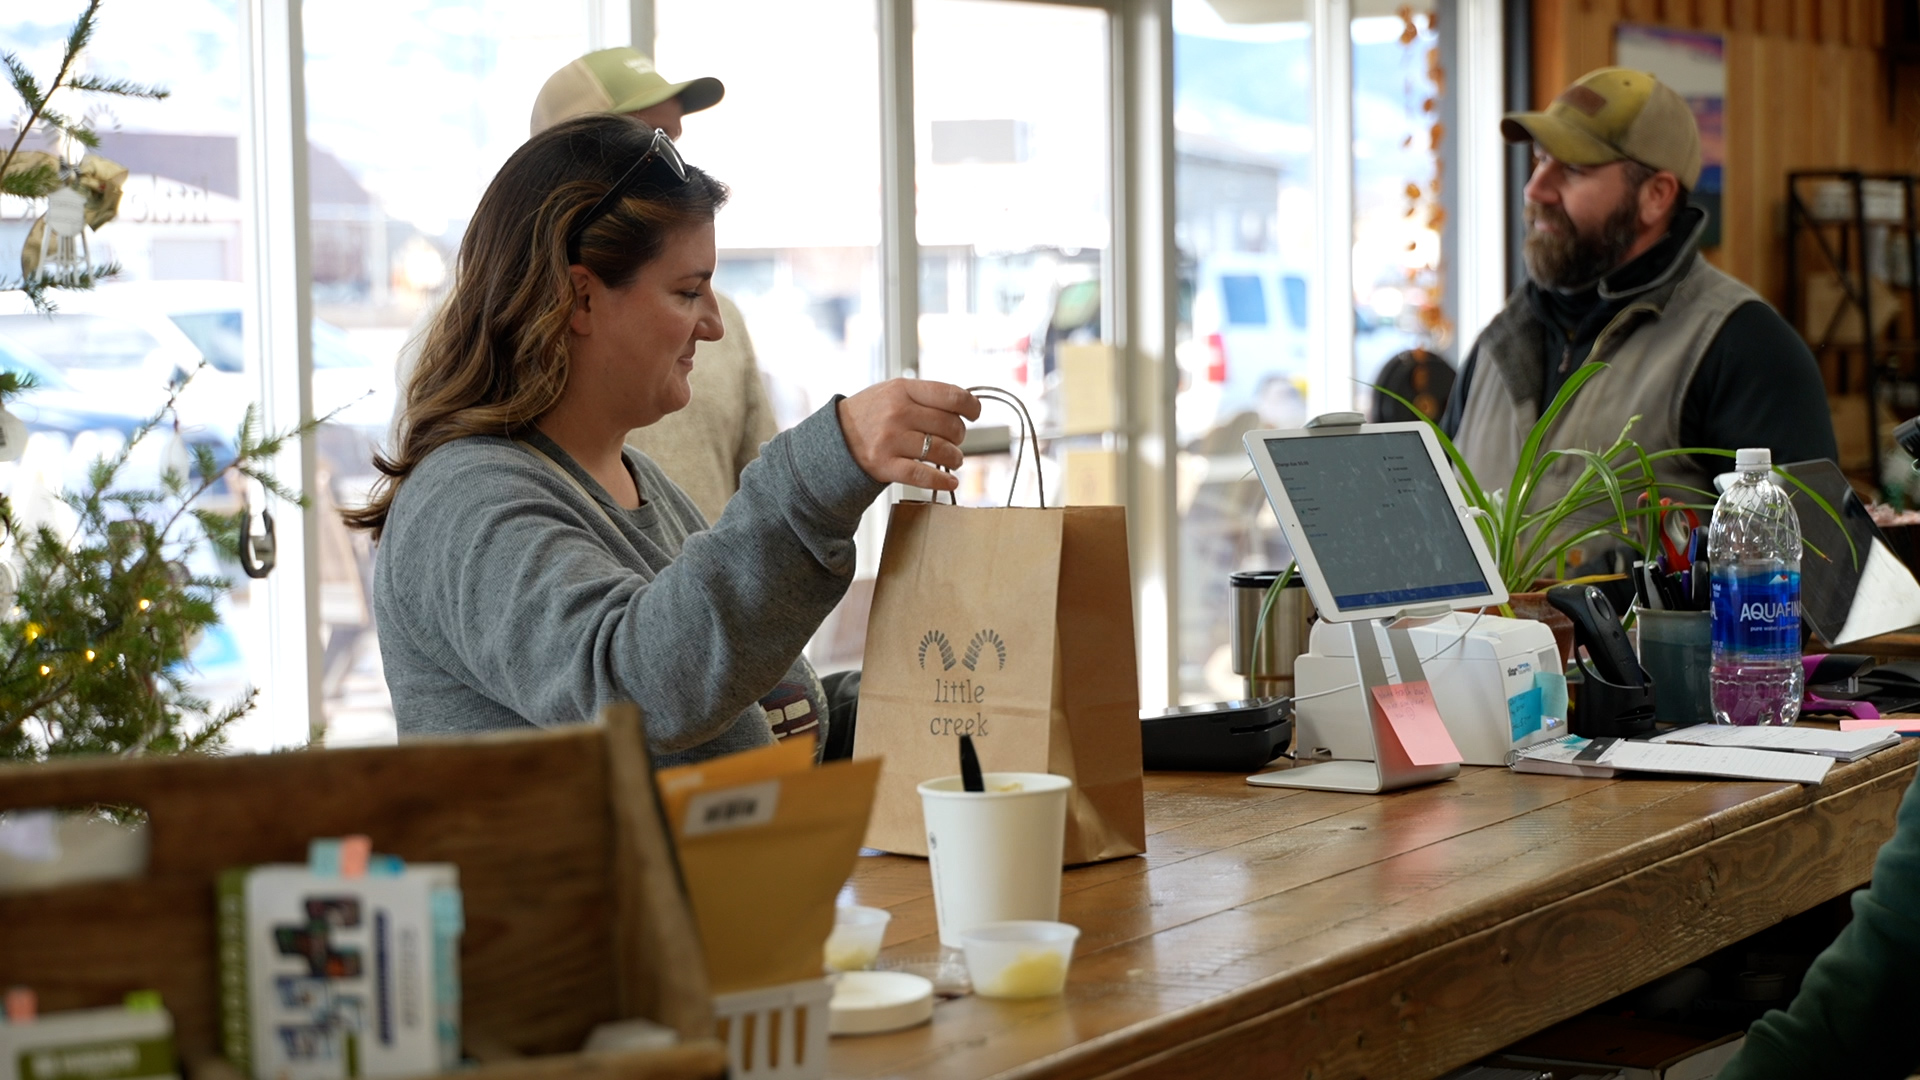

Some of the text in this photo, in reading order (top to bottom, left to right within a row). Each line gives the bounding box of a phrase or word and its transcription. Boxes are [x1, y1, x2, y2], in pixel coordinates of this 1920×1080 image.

[1740, 601, 1801, 622] AQUAFIN
[934, 679, 985, 704] little
[930, 712, 989, 737] creek
